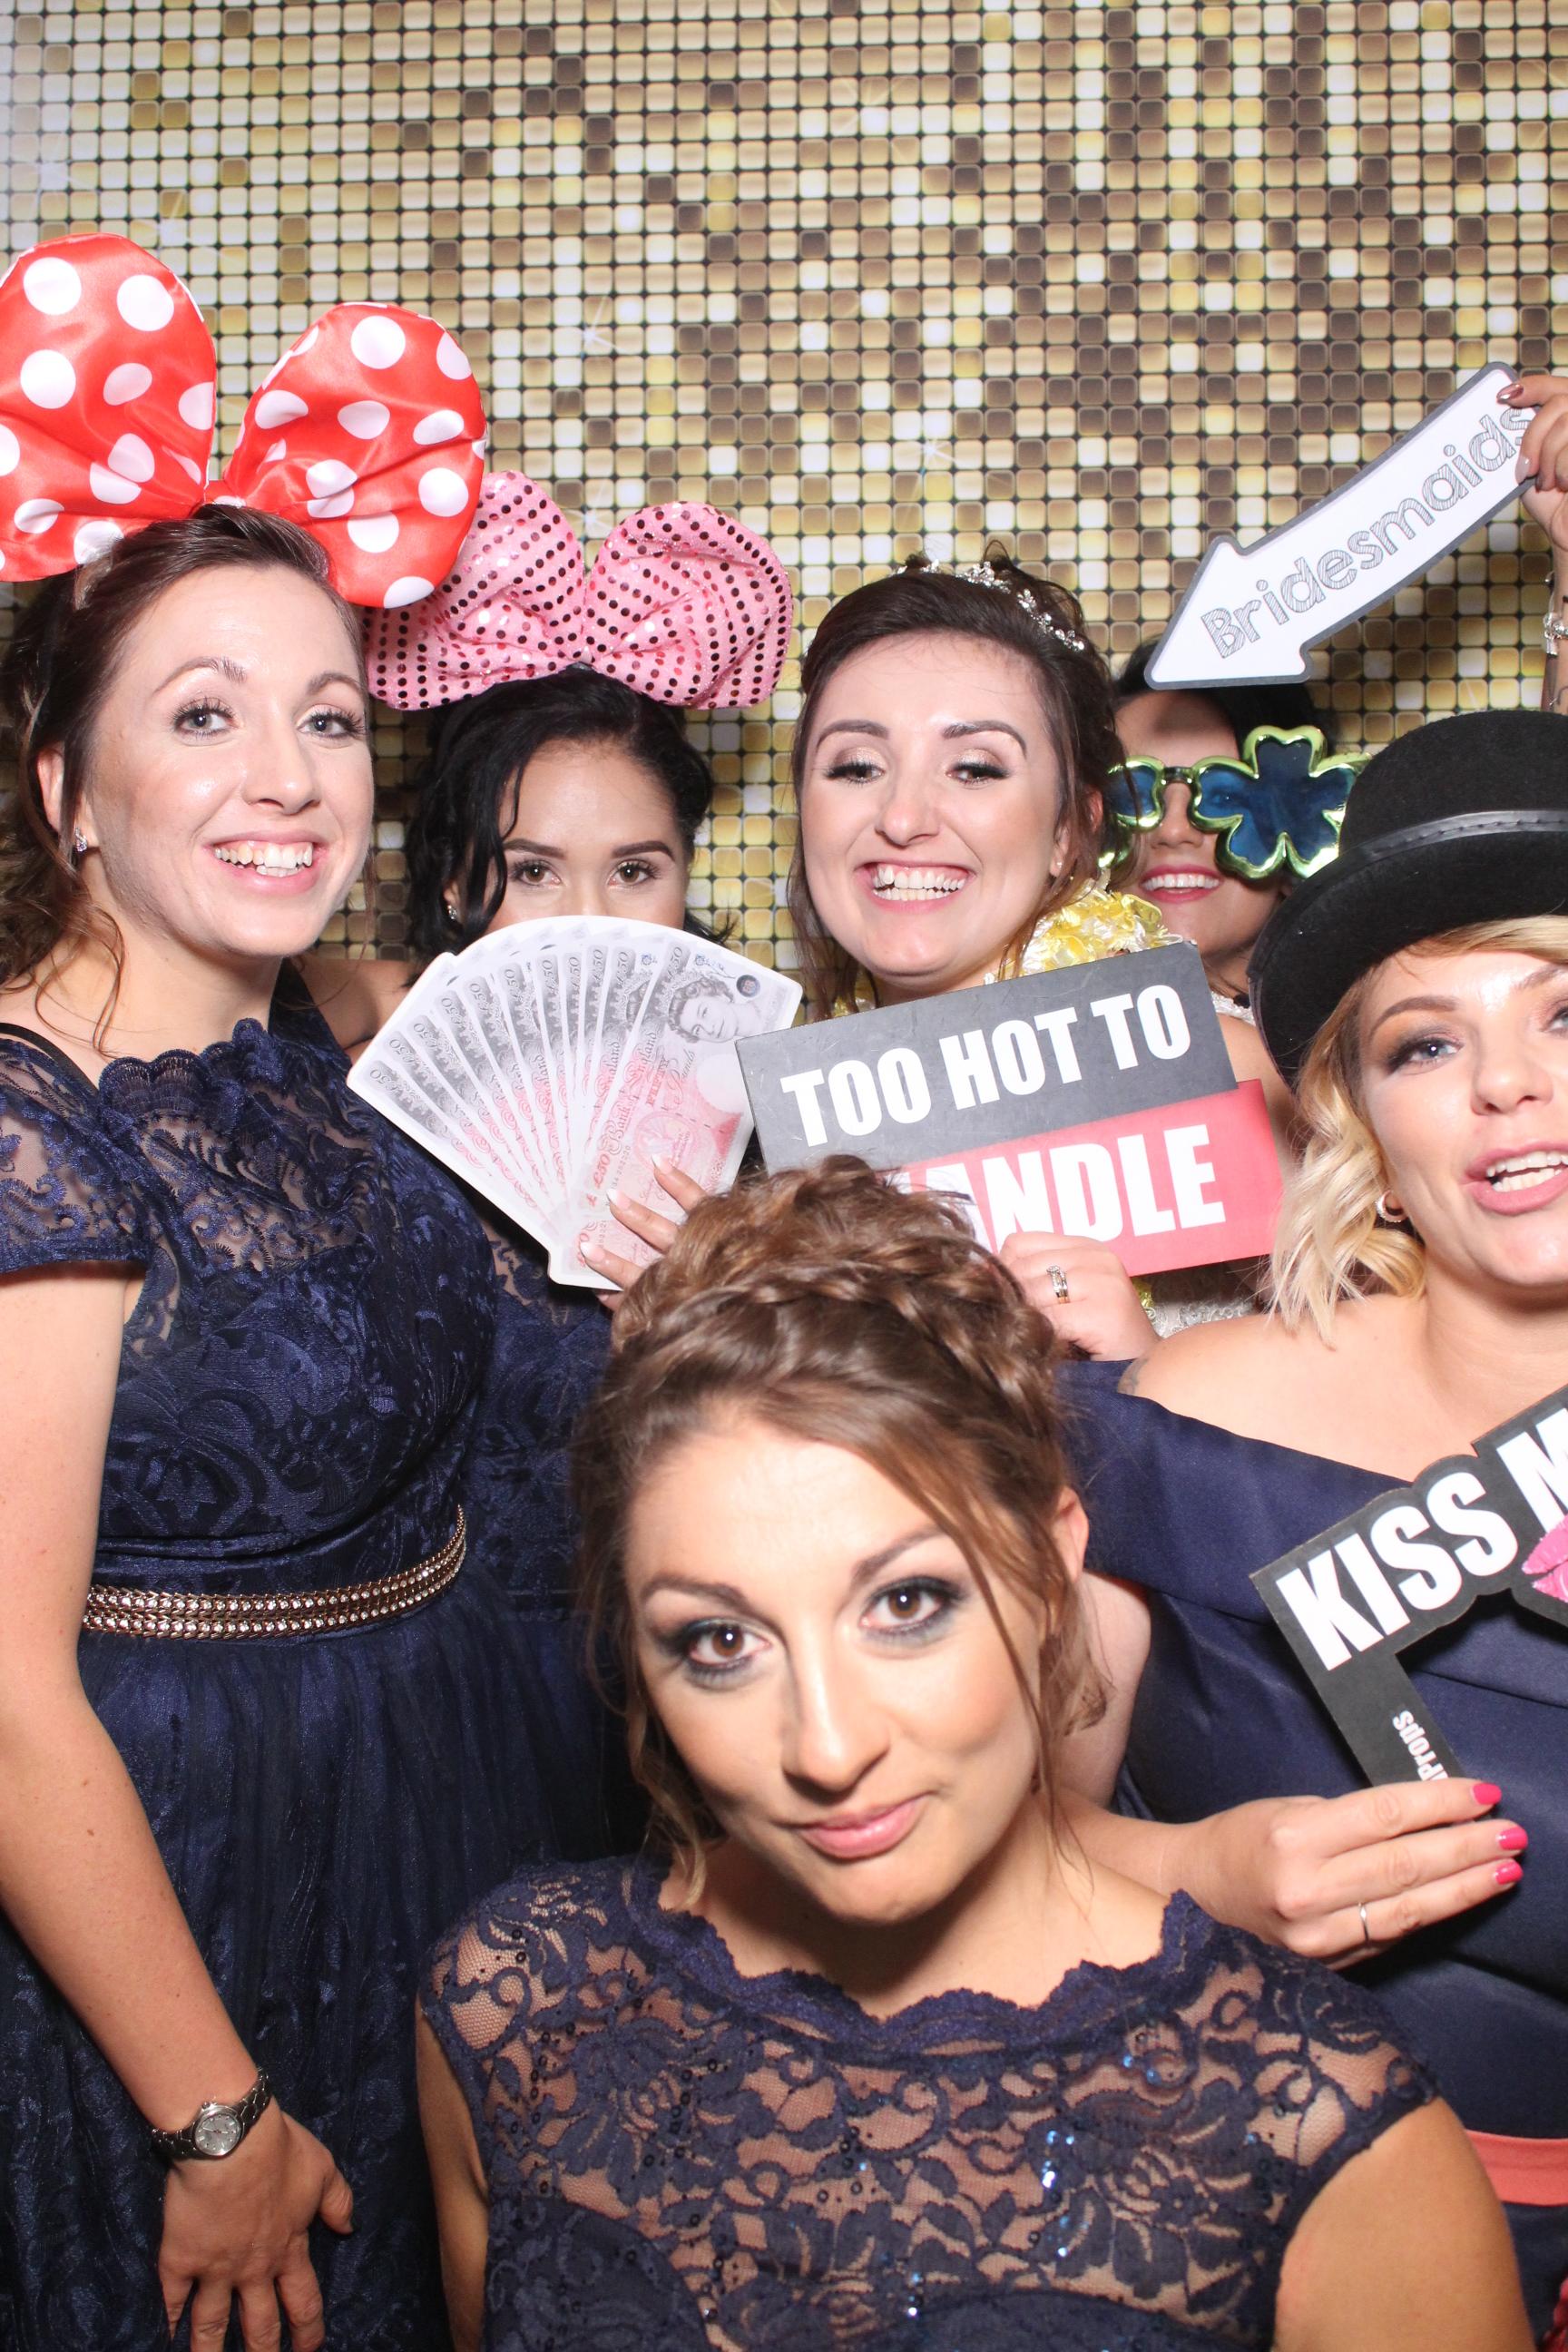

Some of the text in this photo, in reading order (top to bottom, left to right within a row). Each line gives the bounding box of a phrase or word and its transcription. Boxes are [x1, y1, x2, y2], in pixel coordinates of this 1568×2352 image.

[1200, 407, 1534, 659] Bridesmaids
[780, 985, 1191, 1147] TOO HOT TO
[886, 1124, 1226, 1254] ANDLE
[1276, 1472, 1518, 1671] KISS
[1392, 1710, 1450, 1781] Props
